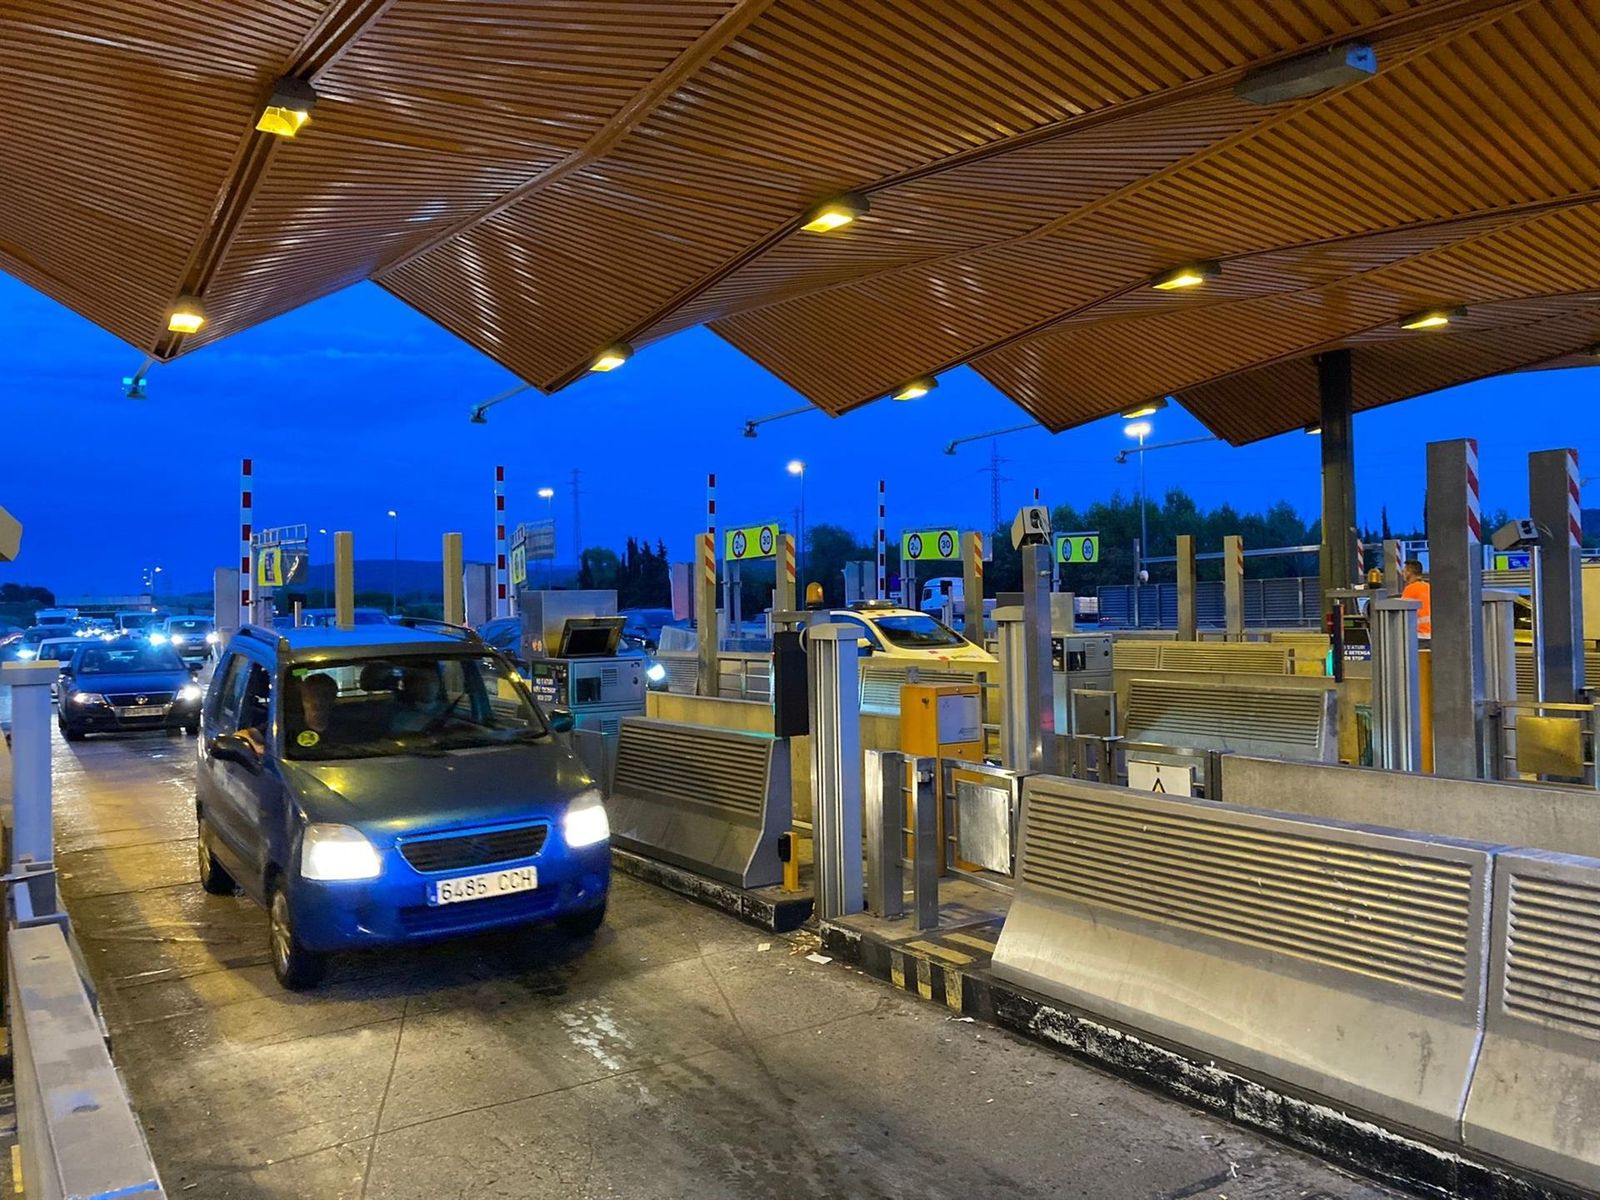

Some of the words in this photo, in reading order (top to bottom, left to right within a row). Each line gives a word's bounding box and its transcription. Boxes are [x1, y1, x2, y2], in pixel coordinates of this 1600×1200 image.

[940, 540, 951, 549] 30
[441, 877, 488, 901] 6485
[498, 868, 532, 891] CCH
